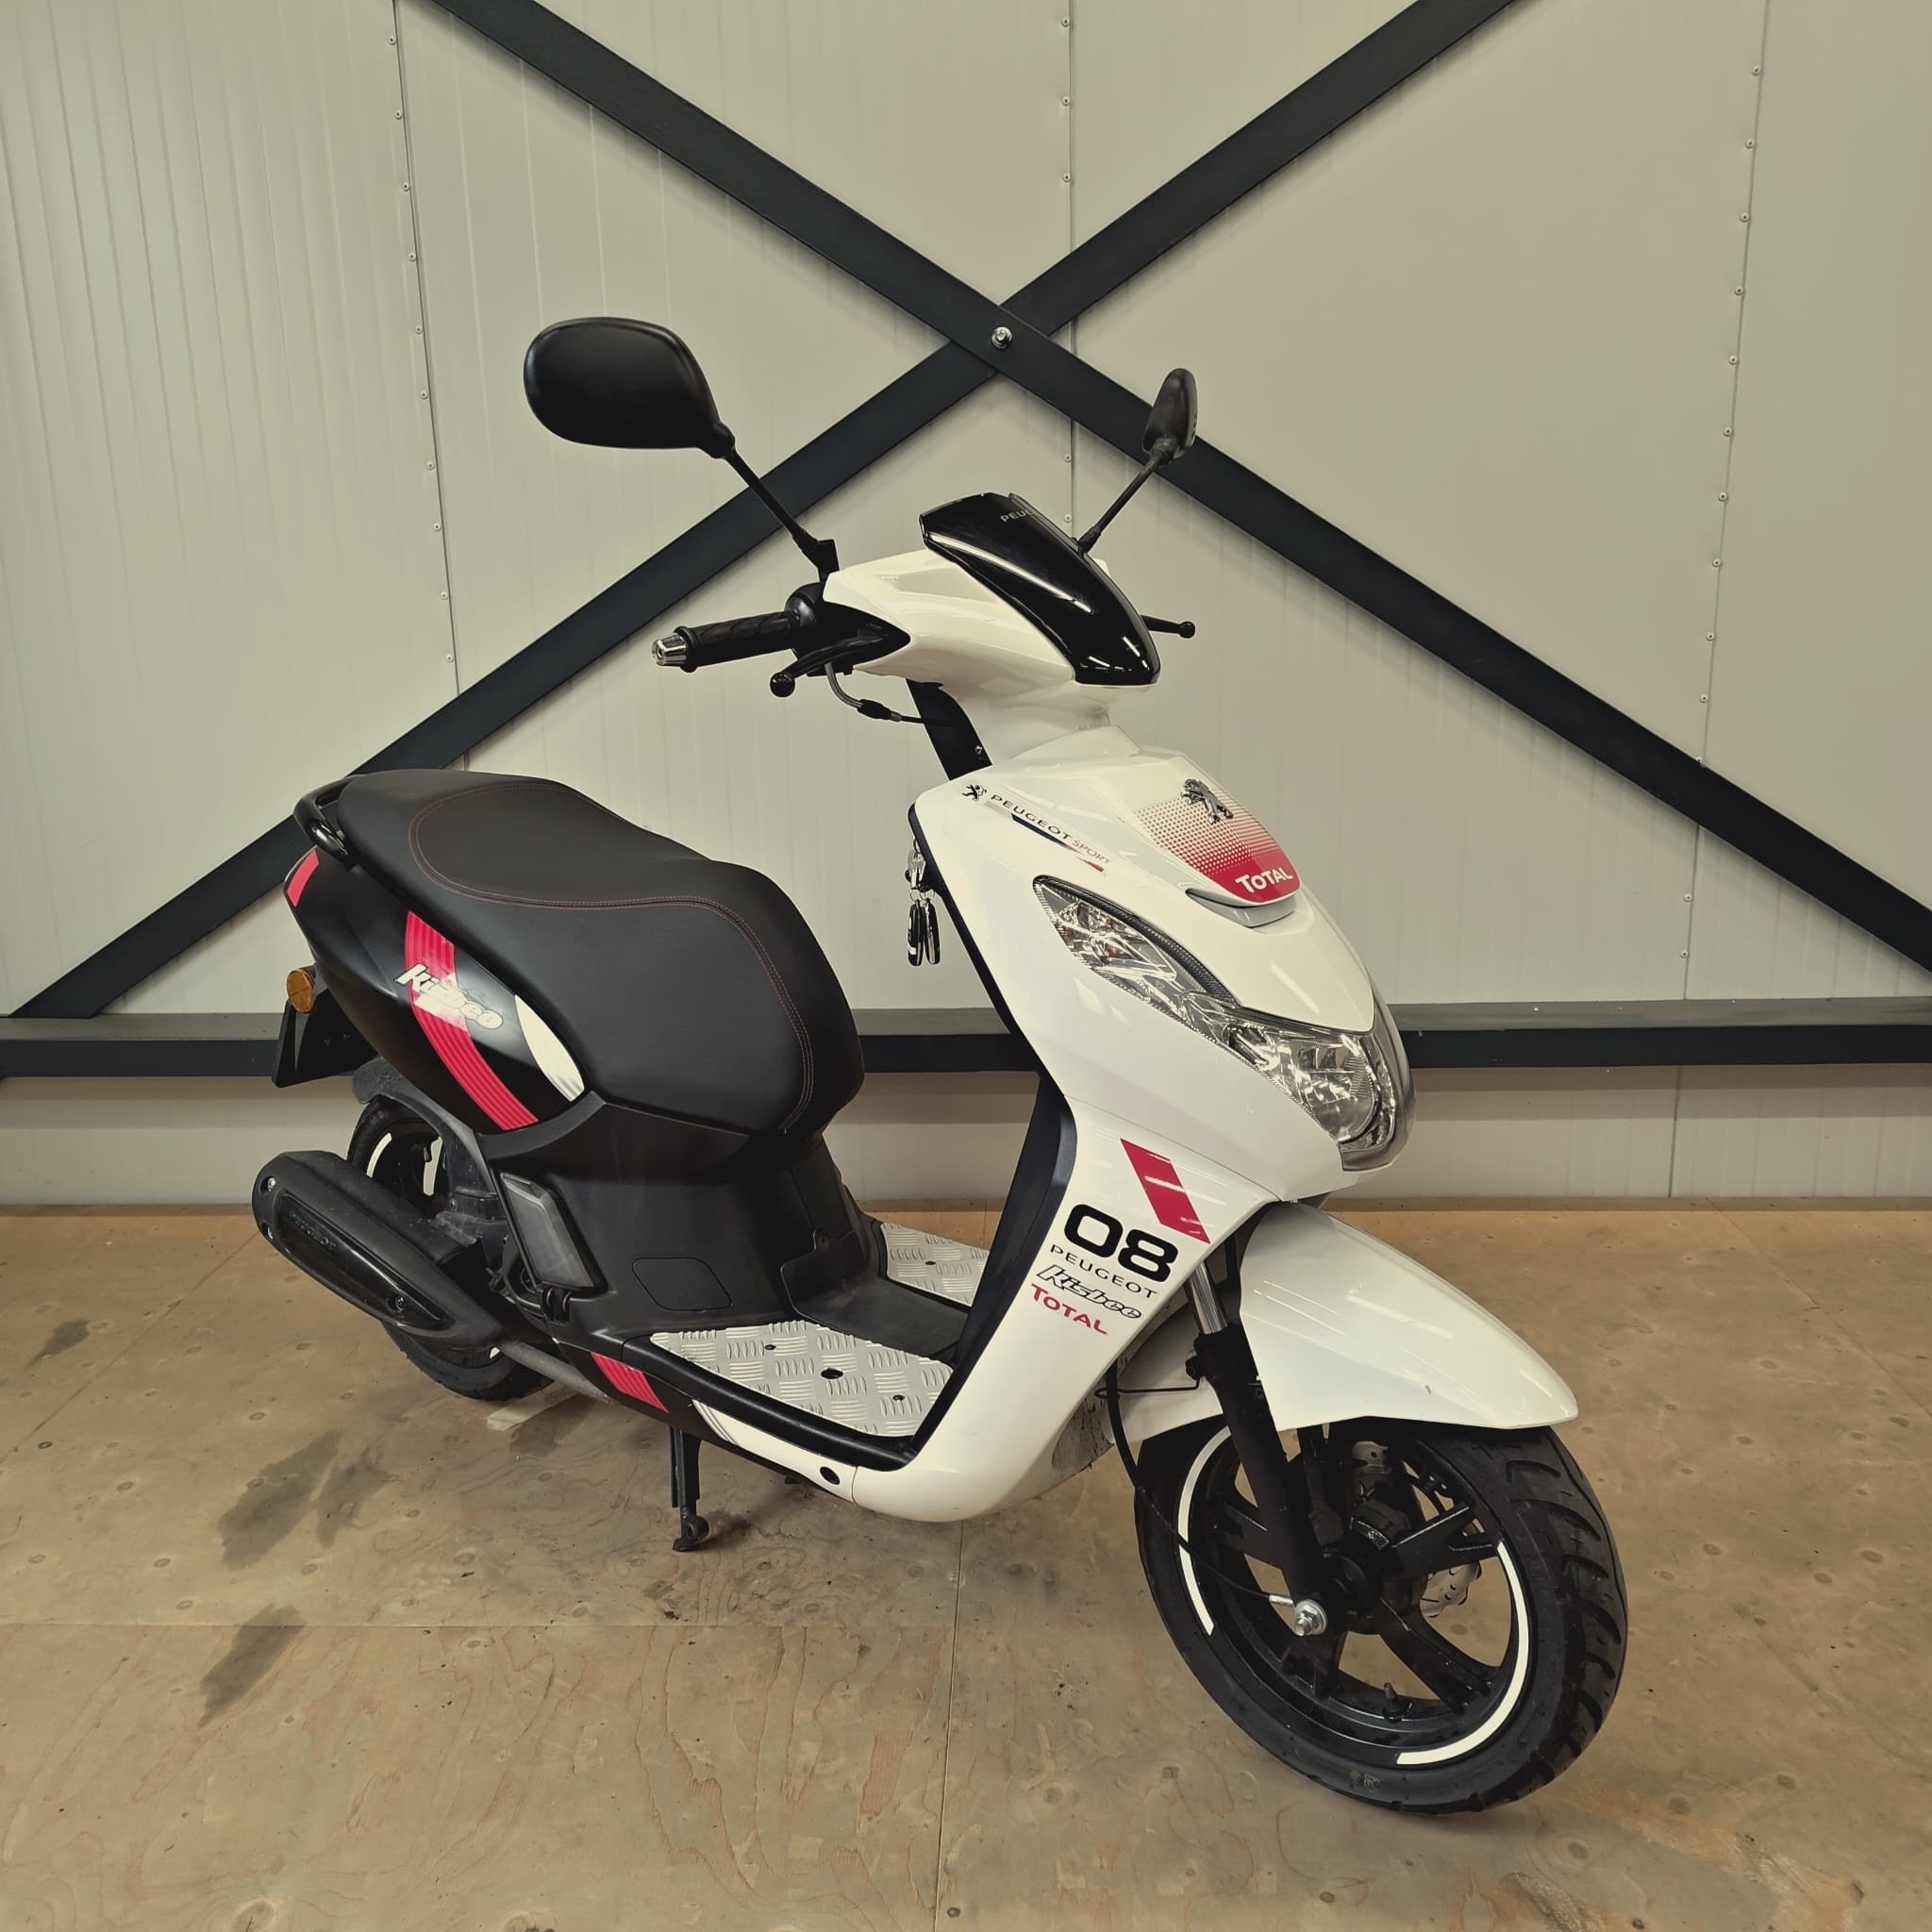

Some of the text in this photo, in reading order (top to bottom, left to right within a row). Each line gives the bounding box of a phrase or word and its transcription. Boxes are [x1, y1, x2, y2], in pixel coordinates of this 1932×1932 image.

[991, 794, 1111, 864] PEUGEOT SPORT
[1234, 867, 1293, 893] TOTAL
[393, 963, 503, 1029] Kiee
[1050, 1244, 1158, 1299] PEUGEOT
[1063, 1204, 1179, 1283] 08
[1031, 1283, 1108, 1335] TOTAL
